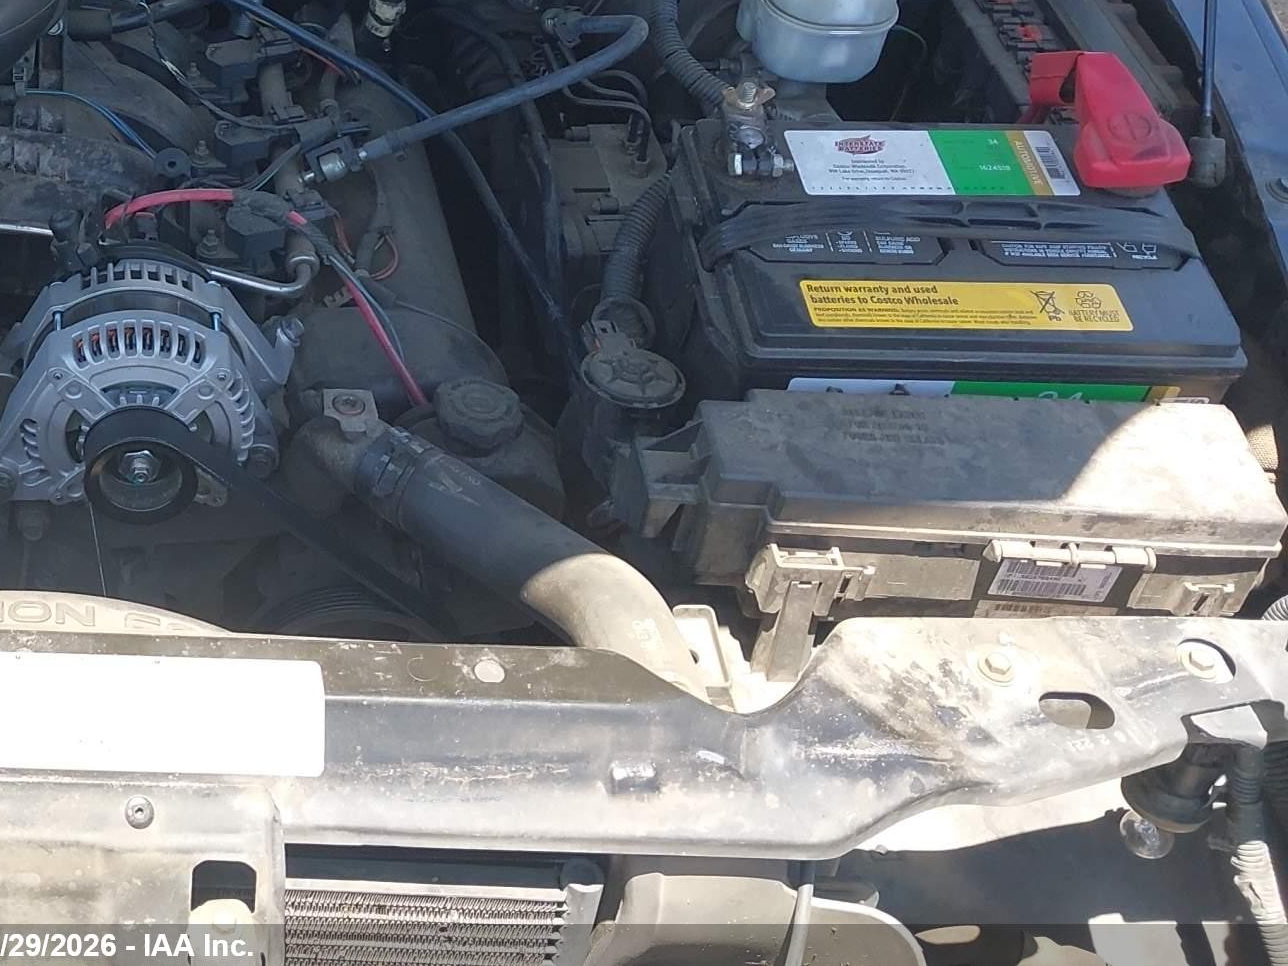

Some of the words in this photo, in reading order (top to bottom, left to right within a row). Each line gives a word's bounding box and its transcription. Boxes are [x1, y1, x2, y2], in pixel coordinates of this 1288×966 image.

[1014, 140, 1043, 186] AUTOMOTIVE
[807, 284, 842, 293] Return
[843, 285, 889, 295] warranty
[891, 284, 912, 294] and
[913, 285, 938, 294] used
[810, 295, 855, 304] batteries
[857, 296, 869, 304] to
[870, 295, 903, 305] Costco
[904, 296, 959, 305] Wholesale
